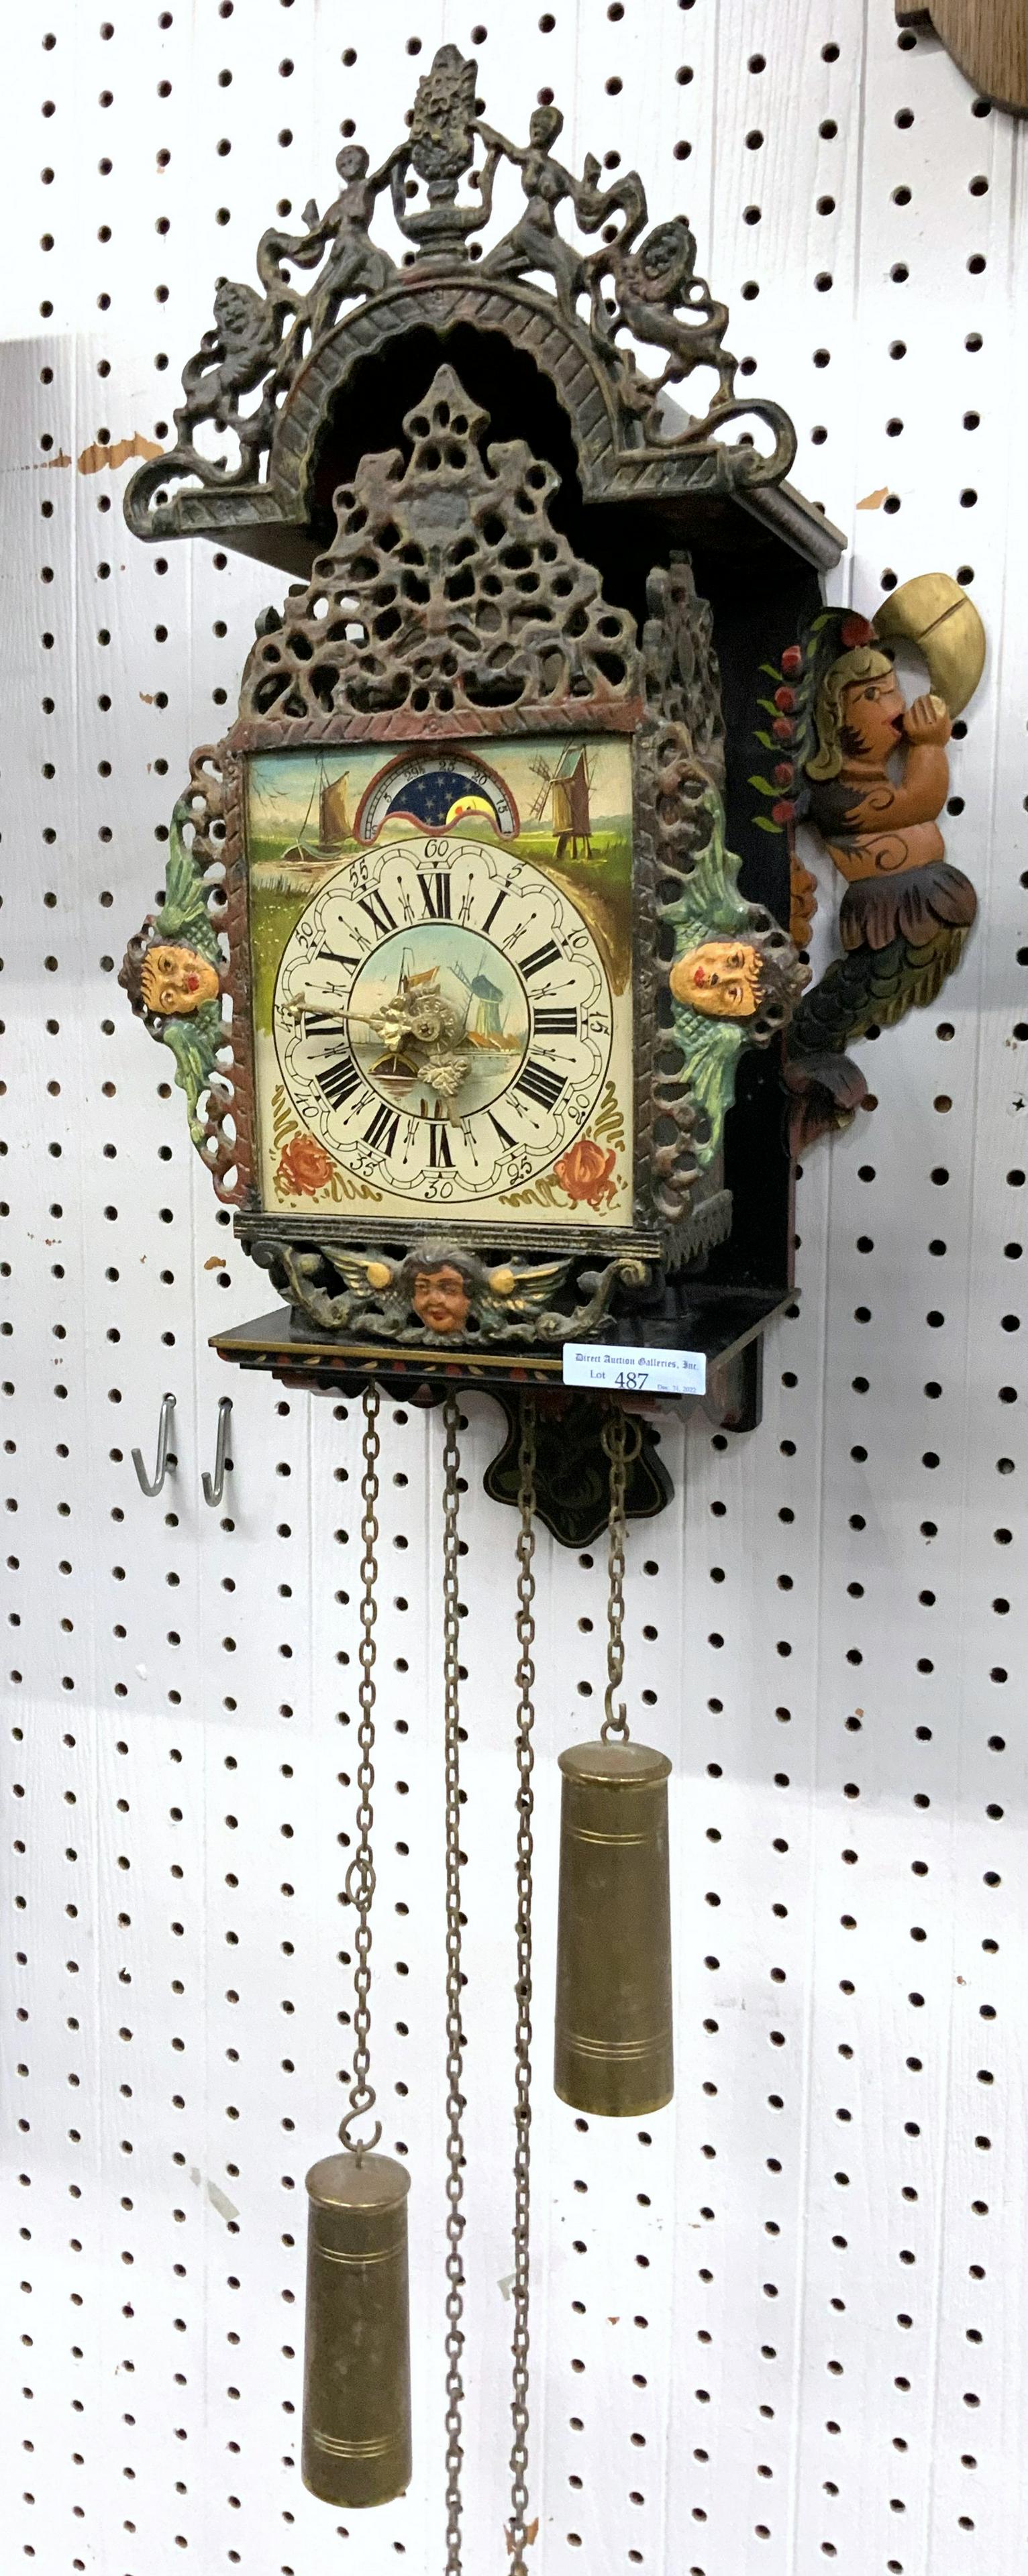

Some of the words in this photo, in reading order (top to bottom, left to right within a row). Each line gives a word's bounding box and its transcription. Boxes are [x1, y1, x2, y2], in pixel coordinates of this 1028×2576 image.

[471, 771, 487, 786] 20
[383, 794, 392, 803] 5
[496, 798, 509, 814] 15
[425, 839, 449, 857] 60
[350, 859, 368, 888] 55
[507, 863, 527, 879] 5
[417, 873, 452, 920] XII
[356, 888, 399, 941] XI
[480, 888, 511, 935] I
[295, 922, 313, 949] 50
[567, 926, 589, 948] 10
[315, 941, 362, 978] X
[515, 938, 563, 982] II
[533, 1006, 577, 1038] III
[589, 1011, 610, 1036] 15
[315, 1055, 366, 1113] VIII
[512, 1057, 568, 1114] IIII
[294, 1092, 319, 1118] 40
[568, 1094, 590, 1125] 20
[360, 1101, 401, 1159] VII
[424, 1122, 456, 1167] VI
[481, 1109, 519, 1153] V
[350, 1152, 378, 1177] 35
[507, 1155, 533, 1185] 25
[424, 1179, 453, 1199] 30
[575, 1353, 601, 1362] Direct
[603, 1354, 635, 1365] Auction
[637, 1357, 680, 1369] Galleries,
[682, 1360, 700, 1370] Inc.
[590, 1370, 606, 1379] Lot
[615, 1372, 649, 1390] 487
